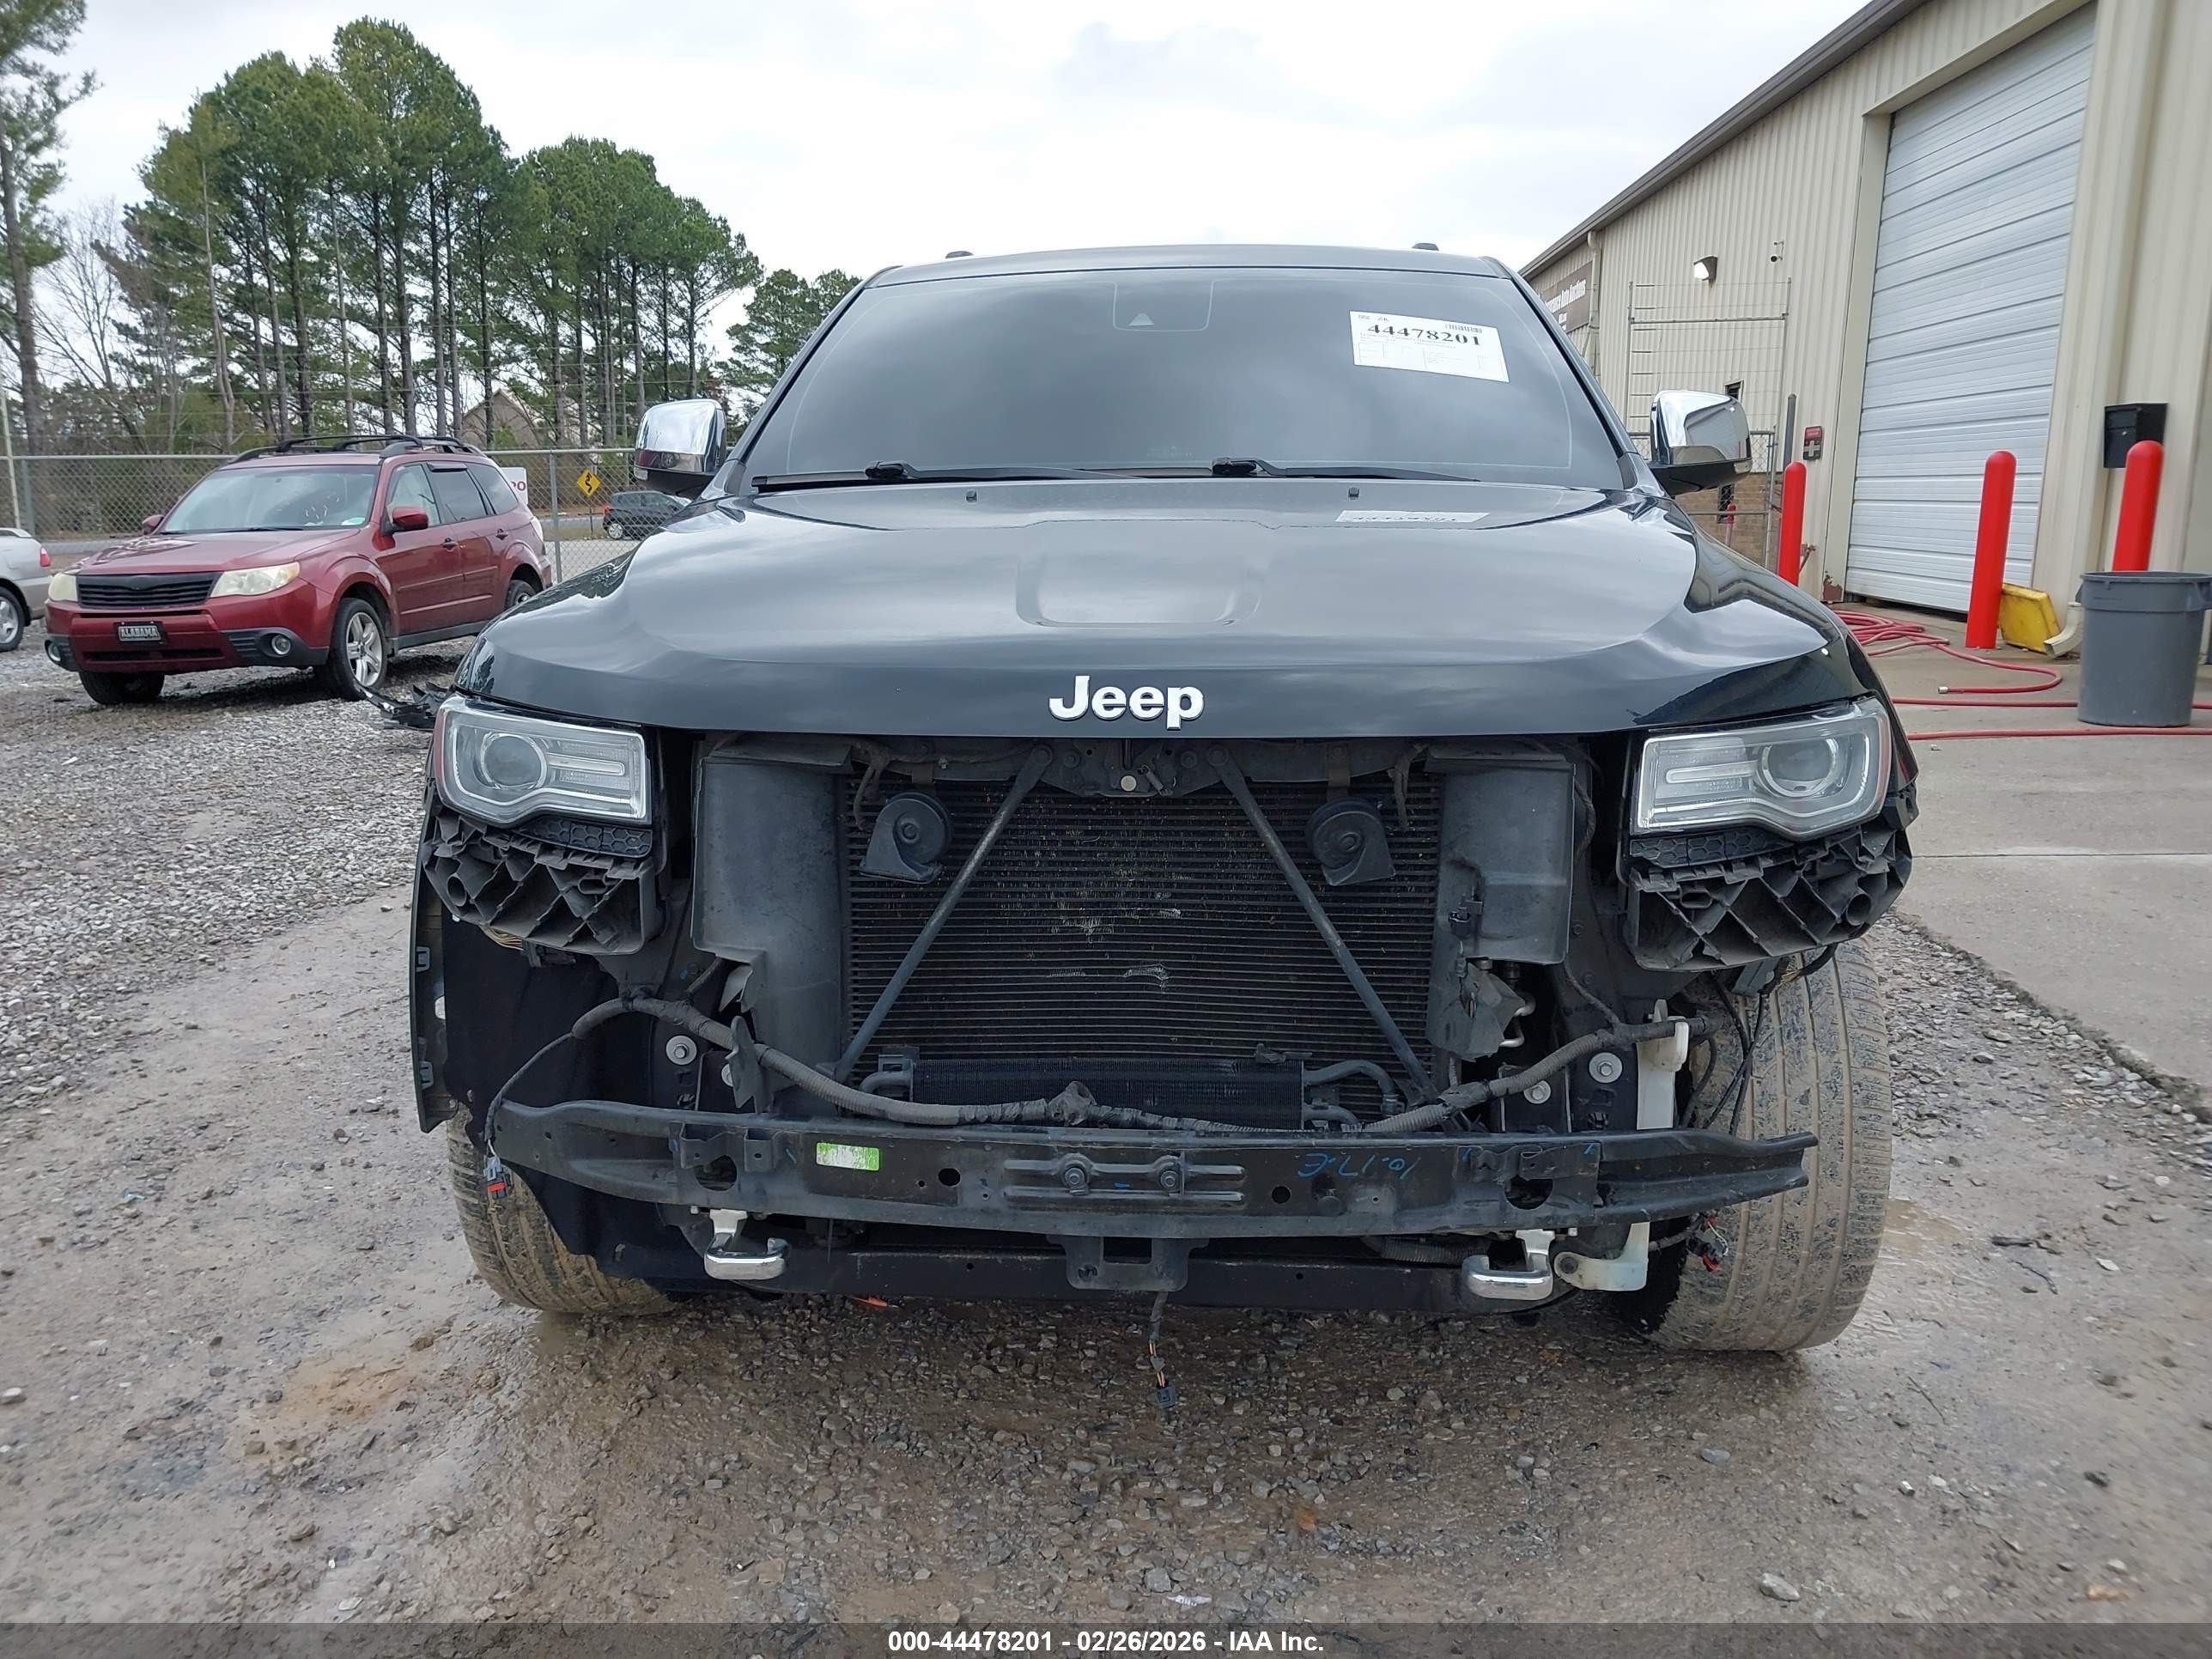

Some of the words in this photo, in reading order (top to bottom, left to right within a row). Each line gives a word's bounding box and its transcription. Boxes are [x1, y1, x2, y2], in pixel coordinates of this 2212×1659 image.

[1367, 324, 1481, 346] 44478201
[121, 628, 158, 637] ALABAMA
[1048, 674, 1205, 732] Jeep
